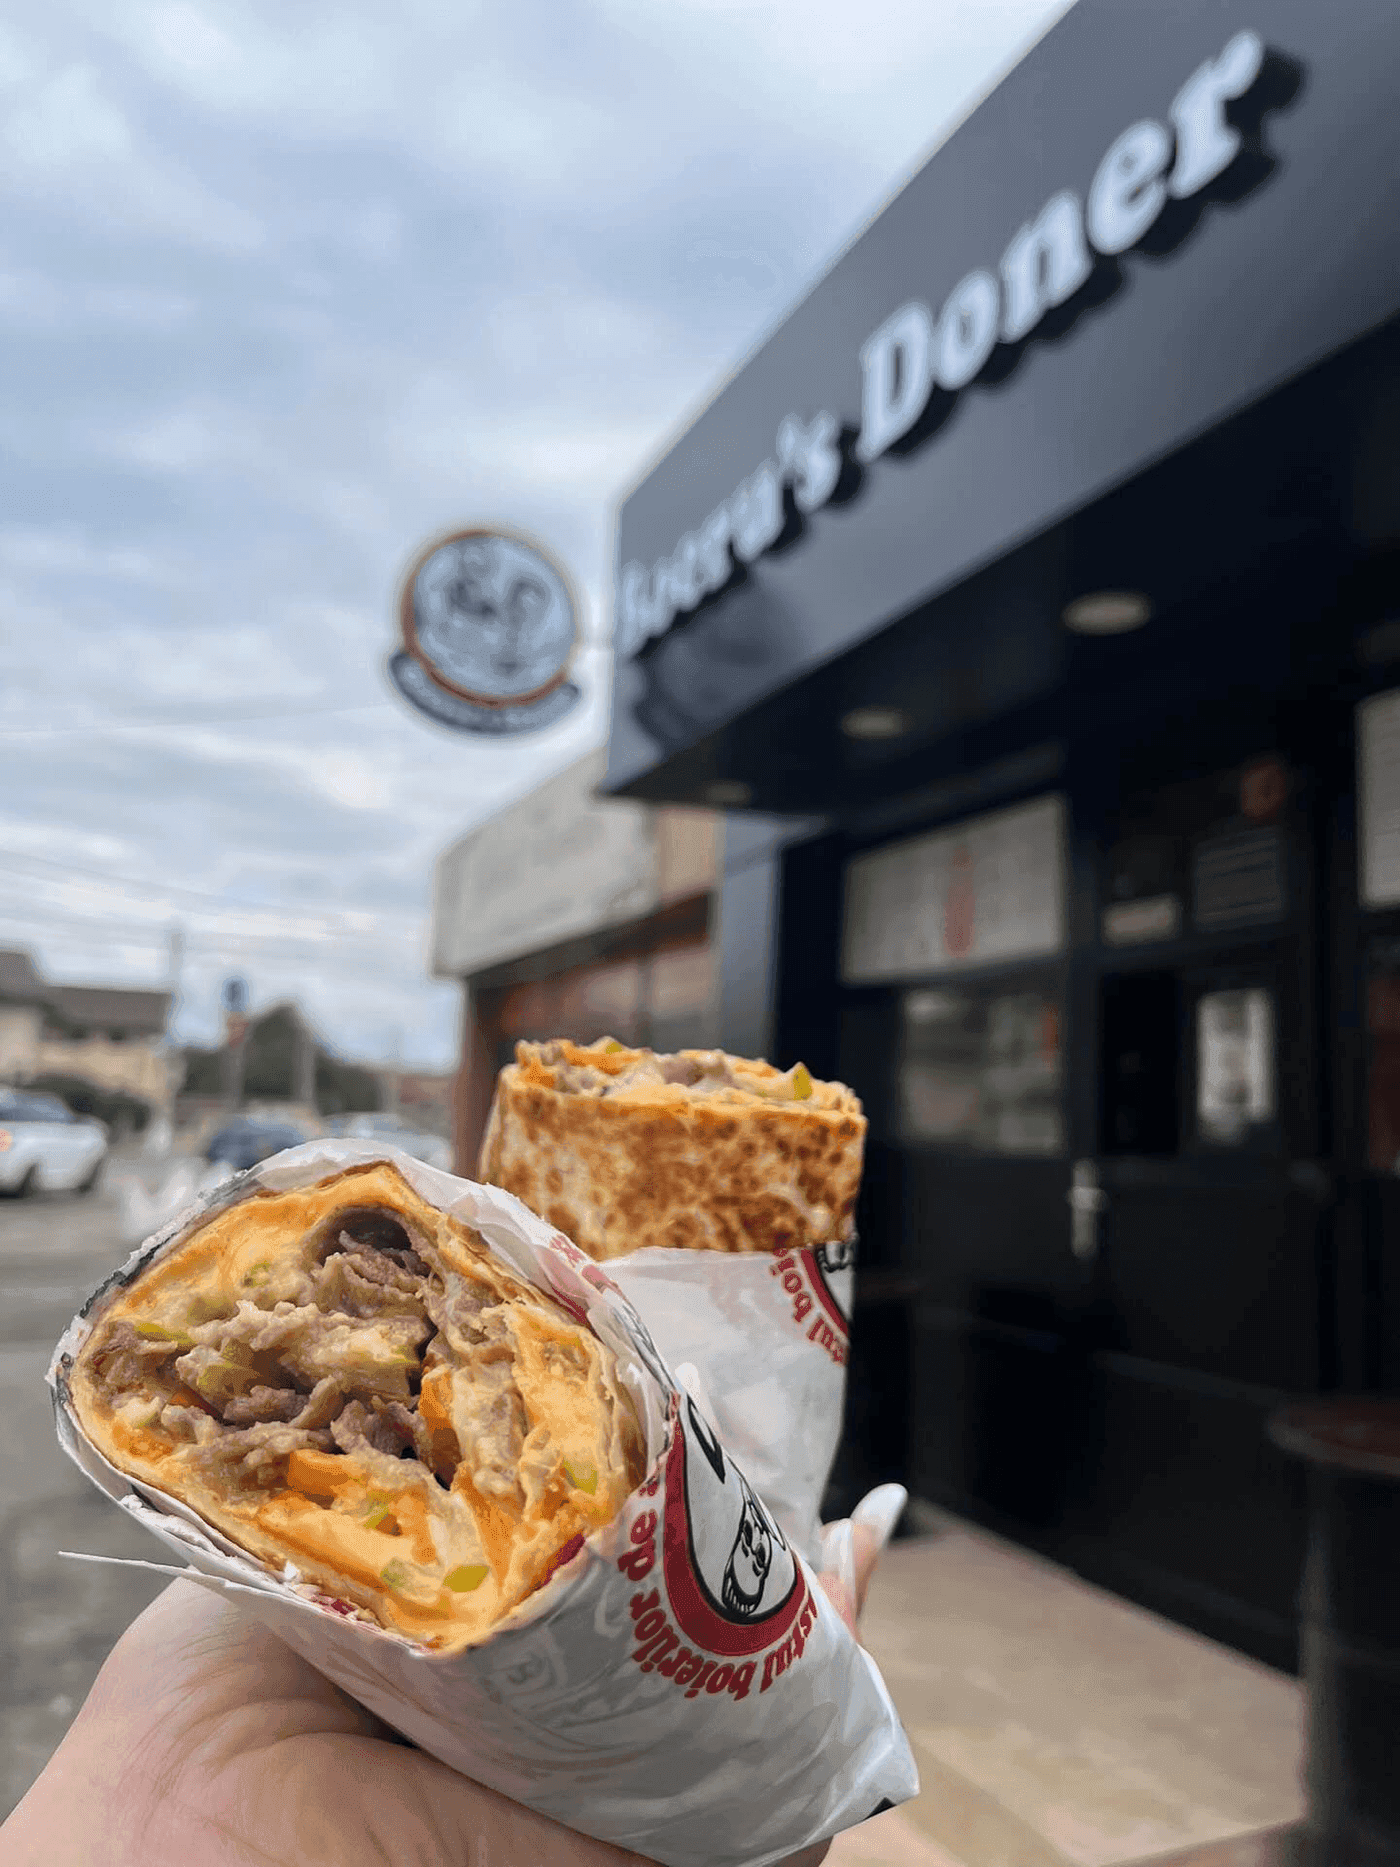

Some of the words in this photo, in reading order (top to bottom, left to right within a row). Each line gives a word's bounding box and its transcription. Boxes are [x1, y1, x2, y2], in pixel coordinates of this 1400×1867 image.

[858, 30, 1264, 462] Doner
[617, 1508, 658, 1582] de
[629, 1588, 757, 1701] boierilor
